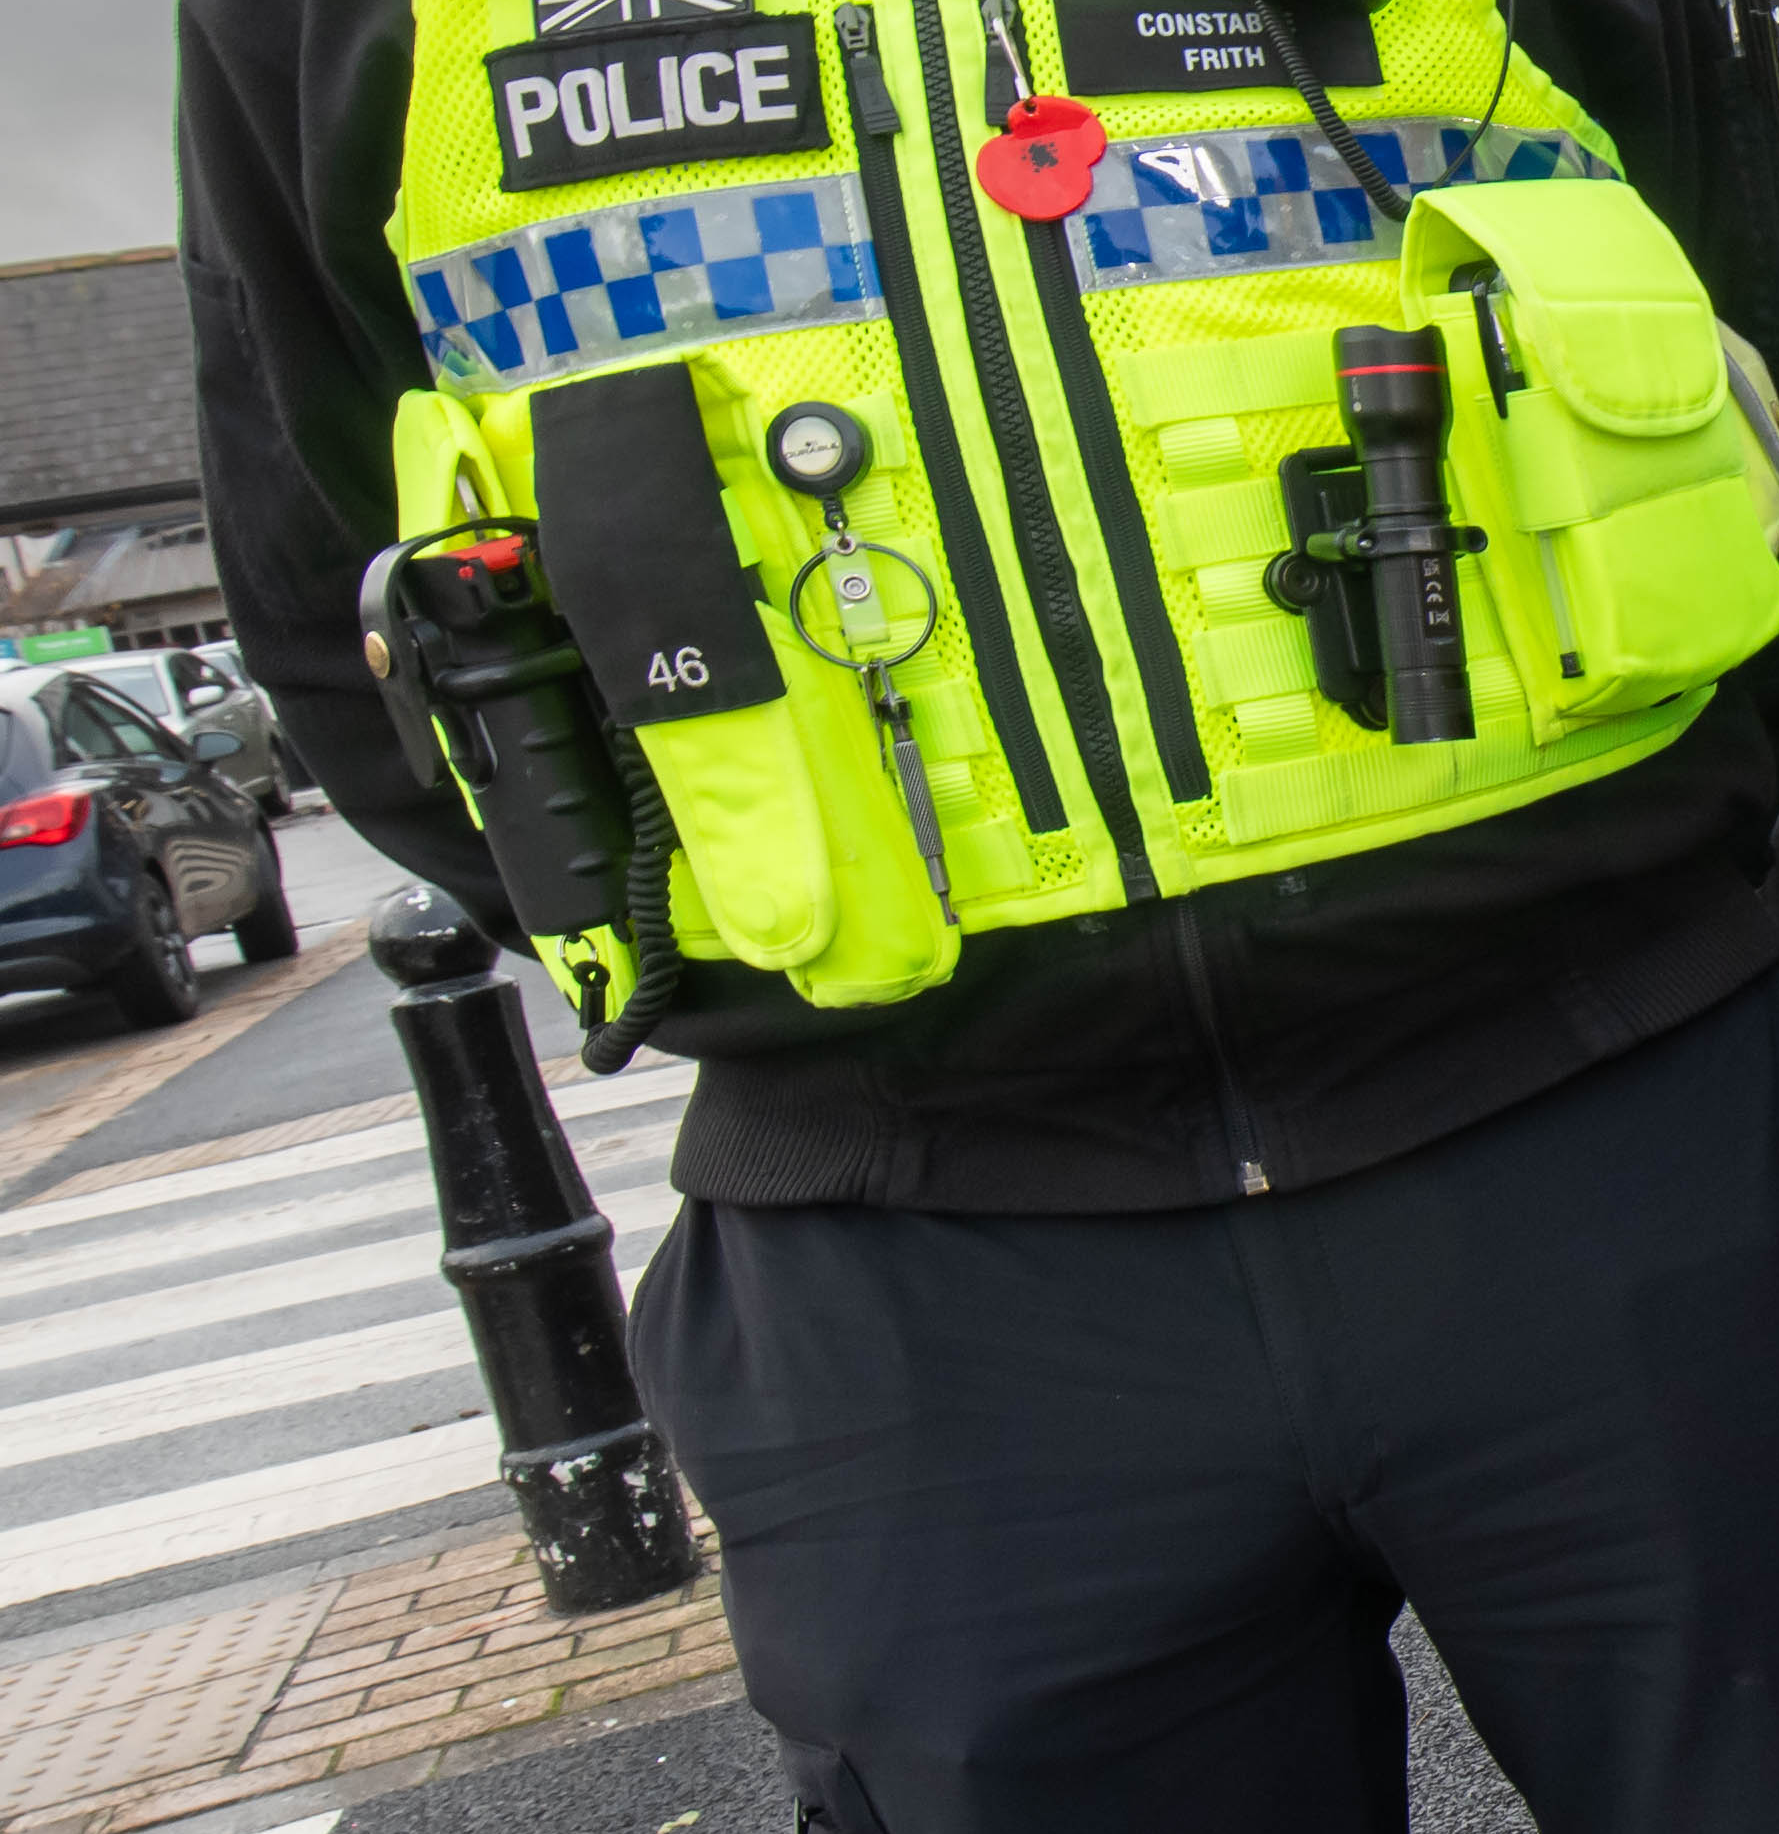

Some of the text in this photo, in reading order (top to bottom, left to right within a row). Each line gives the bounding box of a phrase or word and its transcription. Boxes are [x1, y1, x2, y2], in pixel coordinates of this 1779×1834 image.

[1137, 12, 1264, 37] CONSTAB
[1184, 47, 1266, 71] FRITH
[505, 45, 797, 159] POLICE
[648, 646, 710, 693] 46
